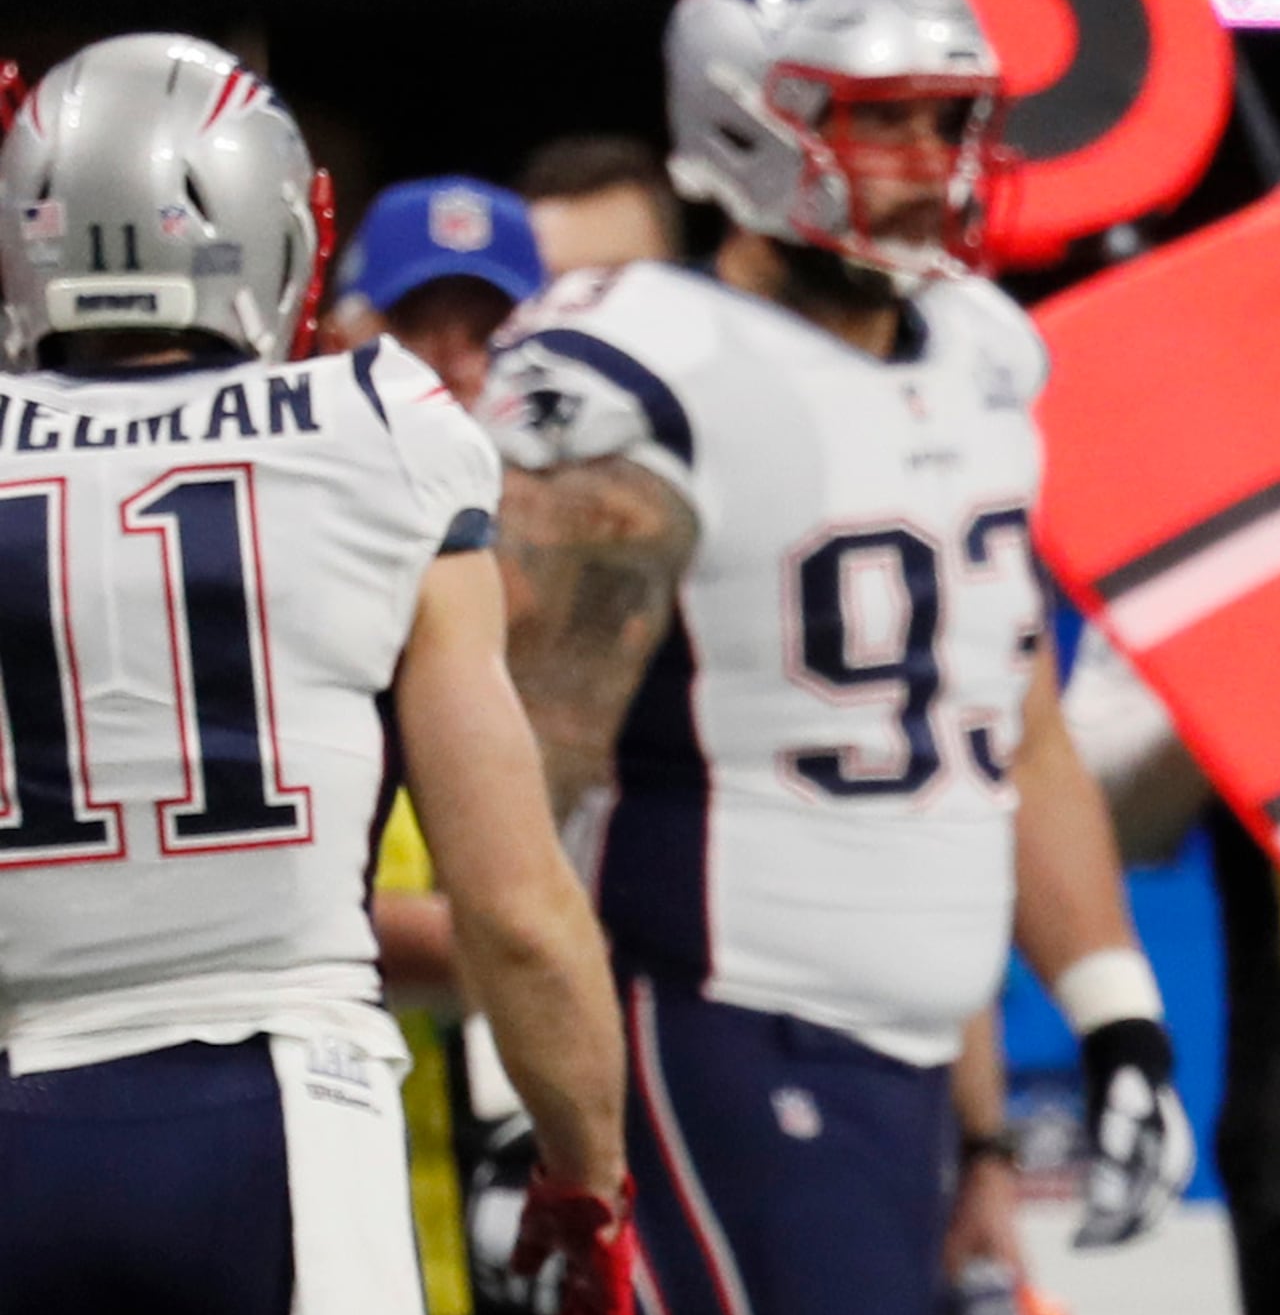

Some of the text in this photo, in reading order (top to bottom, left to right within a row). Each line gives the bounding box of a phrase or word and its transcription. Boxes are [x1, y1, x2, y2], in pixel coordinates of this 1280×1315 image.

[89, 222, 141, 272] 11
[0, 372, 320, 452] ELMAN
[0, 460, 315, 872] 11
